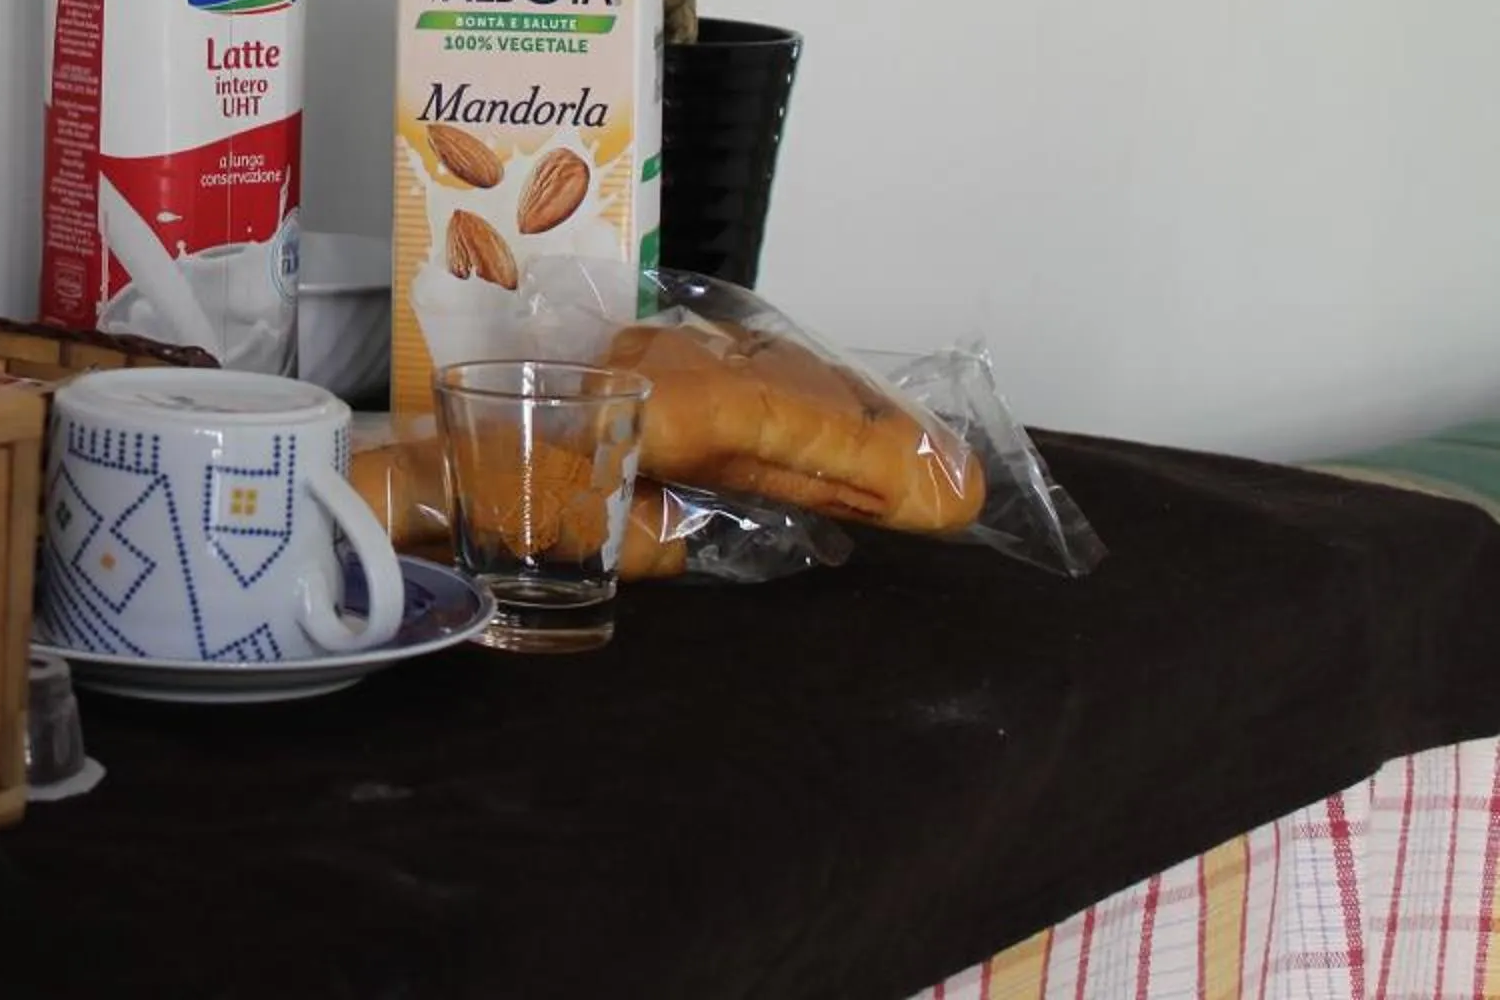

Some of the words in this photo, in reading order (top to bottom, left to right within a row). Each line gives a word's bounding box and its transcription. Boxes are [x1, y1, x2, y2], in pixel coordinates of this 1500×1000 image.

[510, 16, 518, 29] E
[522, 17, 578, 31] SALUTE
[444, 35, 493, 51] 100%
[497, 36, 589, 53] VEGETALE
[206, 38, 281, 71] Latte
[215, 75, 269, 96] intero
[222, 96, 262, 118] UHT
[416, 82, 610, 127] Mandorla
[219, 156, 228, 169] a
[230, 152, 265, 170] lunga
[200, 169, 282, 187] conservazione
